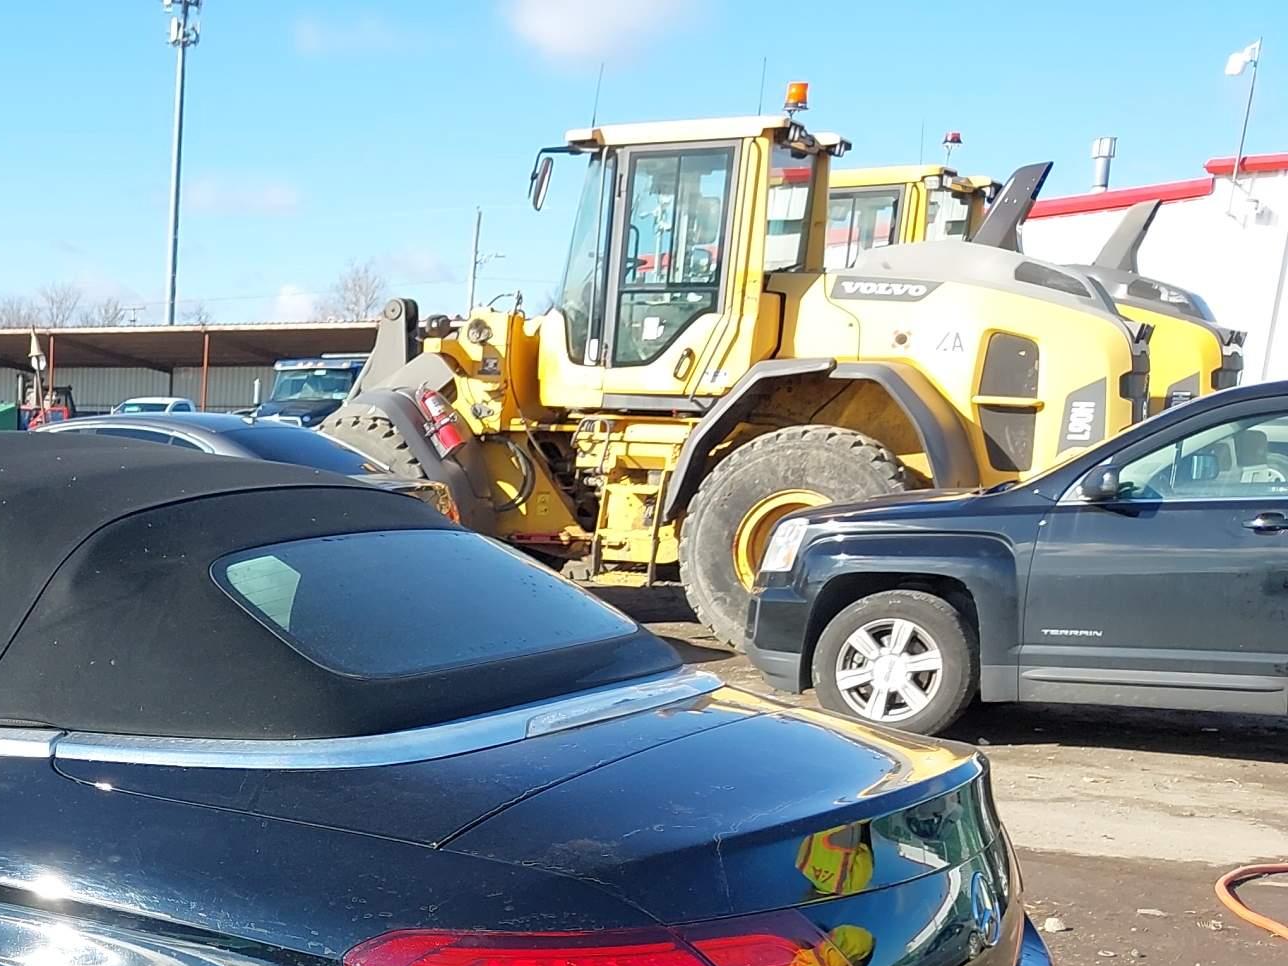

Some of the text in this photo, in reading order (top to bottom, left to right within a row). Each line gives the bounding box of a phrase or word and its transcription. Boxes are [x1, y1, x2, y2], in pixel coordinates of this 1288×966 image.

[841, 281, 928, 297] VOLVO
[1066, 401, 1096, 441] L90H
[1041, 628, 1103, 637] TERRAIN
